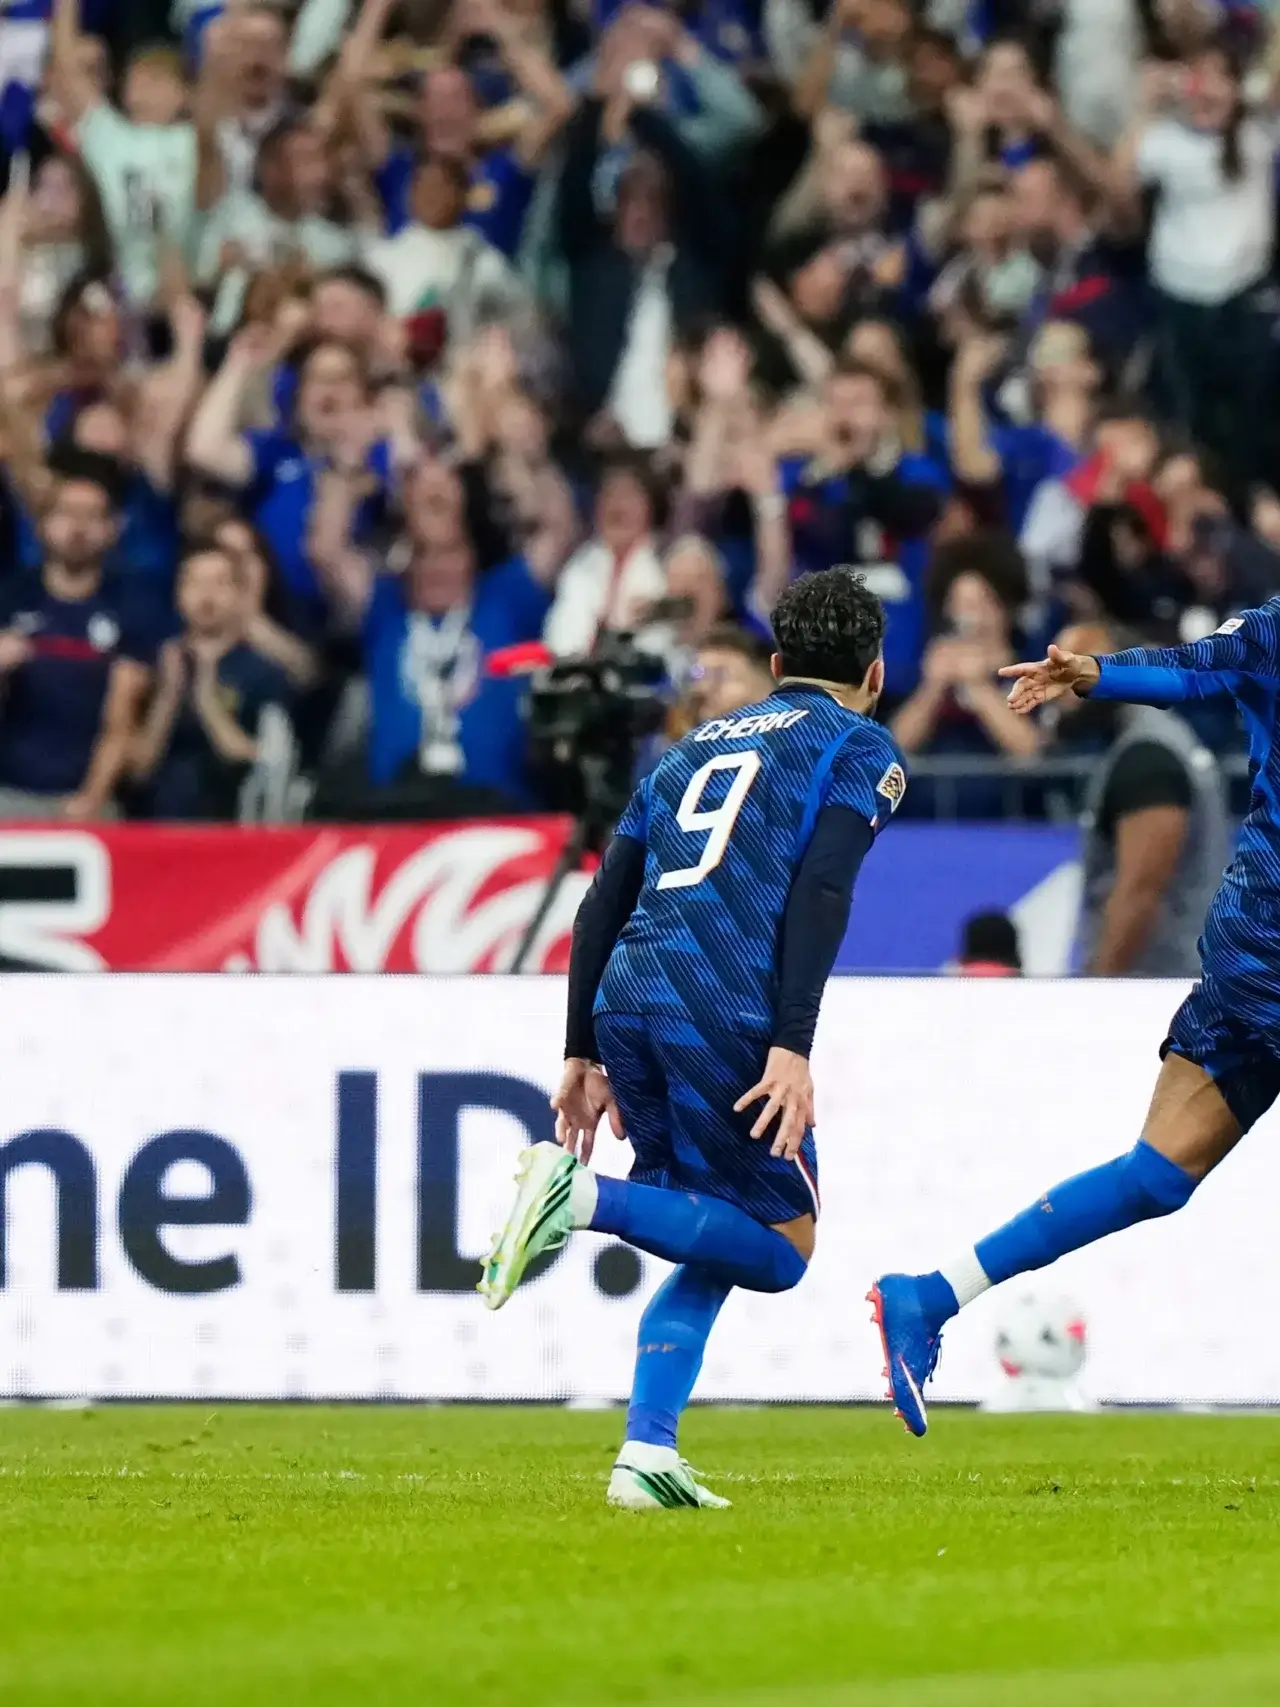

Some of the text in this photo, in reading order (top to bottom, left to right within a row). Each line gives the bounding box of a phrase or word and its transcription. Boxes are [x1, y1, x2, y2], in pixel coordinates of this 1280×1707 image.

[694, 710, 809, 741] CHERKI
[656, 750, 761, 891] 9
[335, 1069, 645, 1298] ID.
